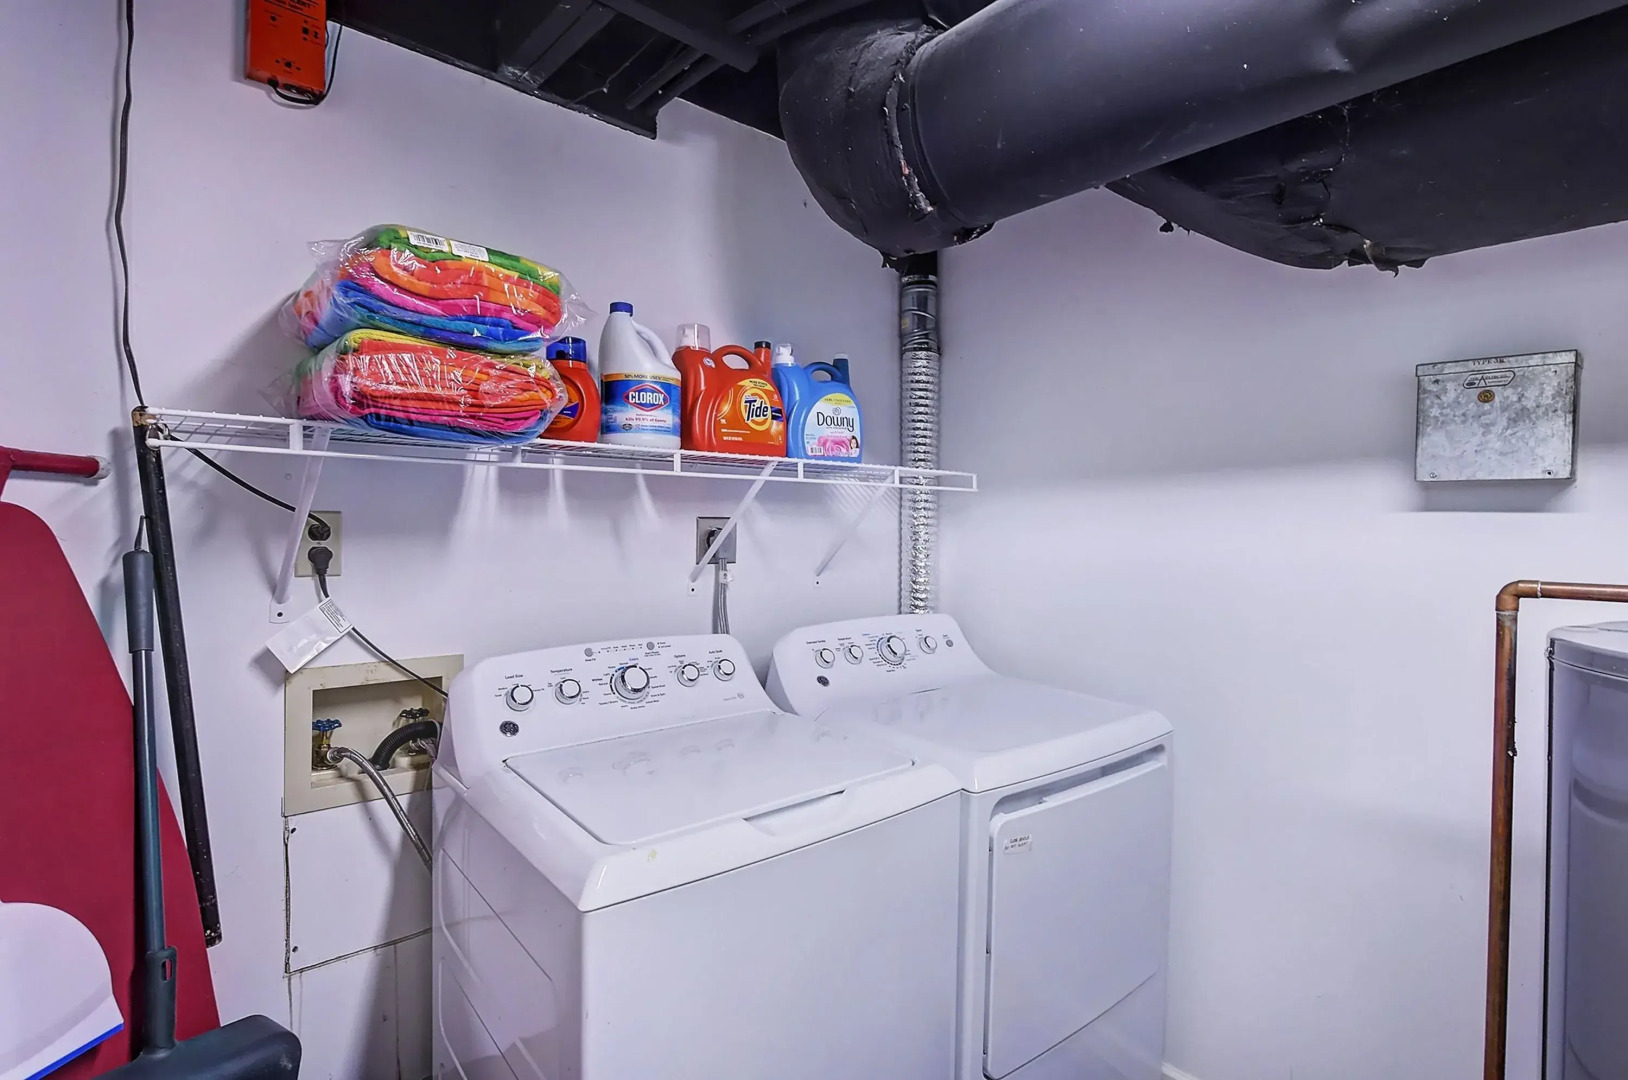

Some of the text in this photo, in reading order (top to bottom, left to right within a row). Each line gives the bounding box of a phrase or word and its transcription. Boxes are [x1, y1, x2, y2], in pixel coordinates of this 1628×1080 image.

[628, 391, 665, 406] CLOROX
[744, 399, 769, 422] Tide
[816, 411, 855, 433] Downy
